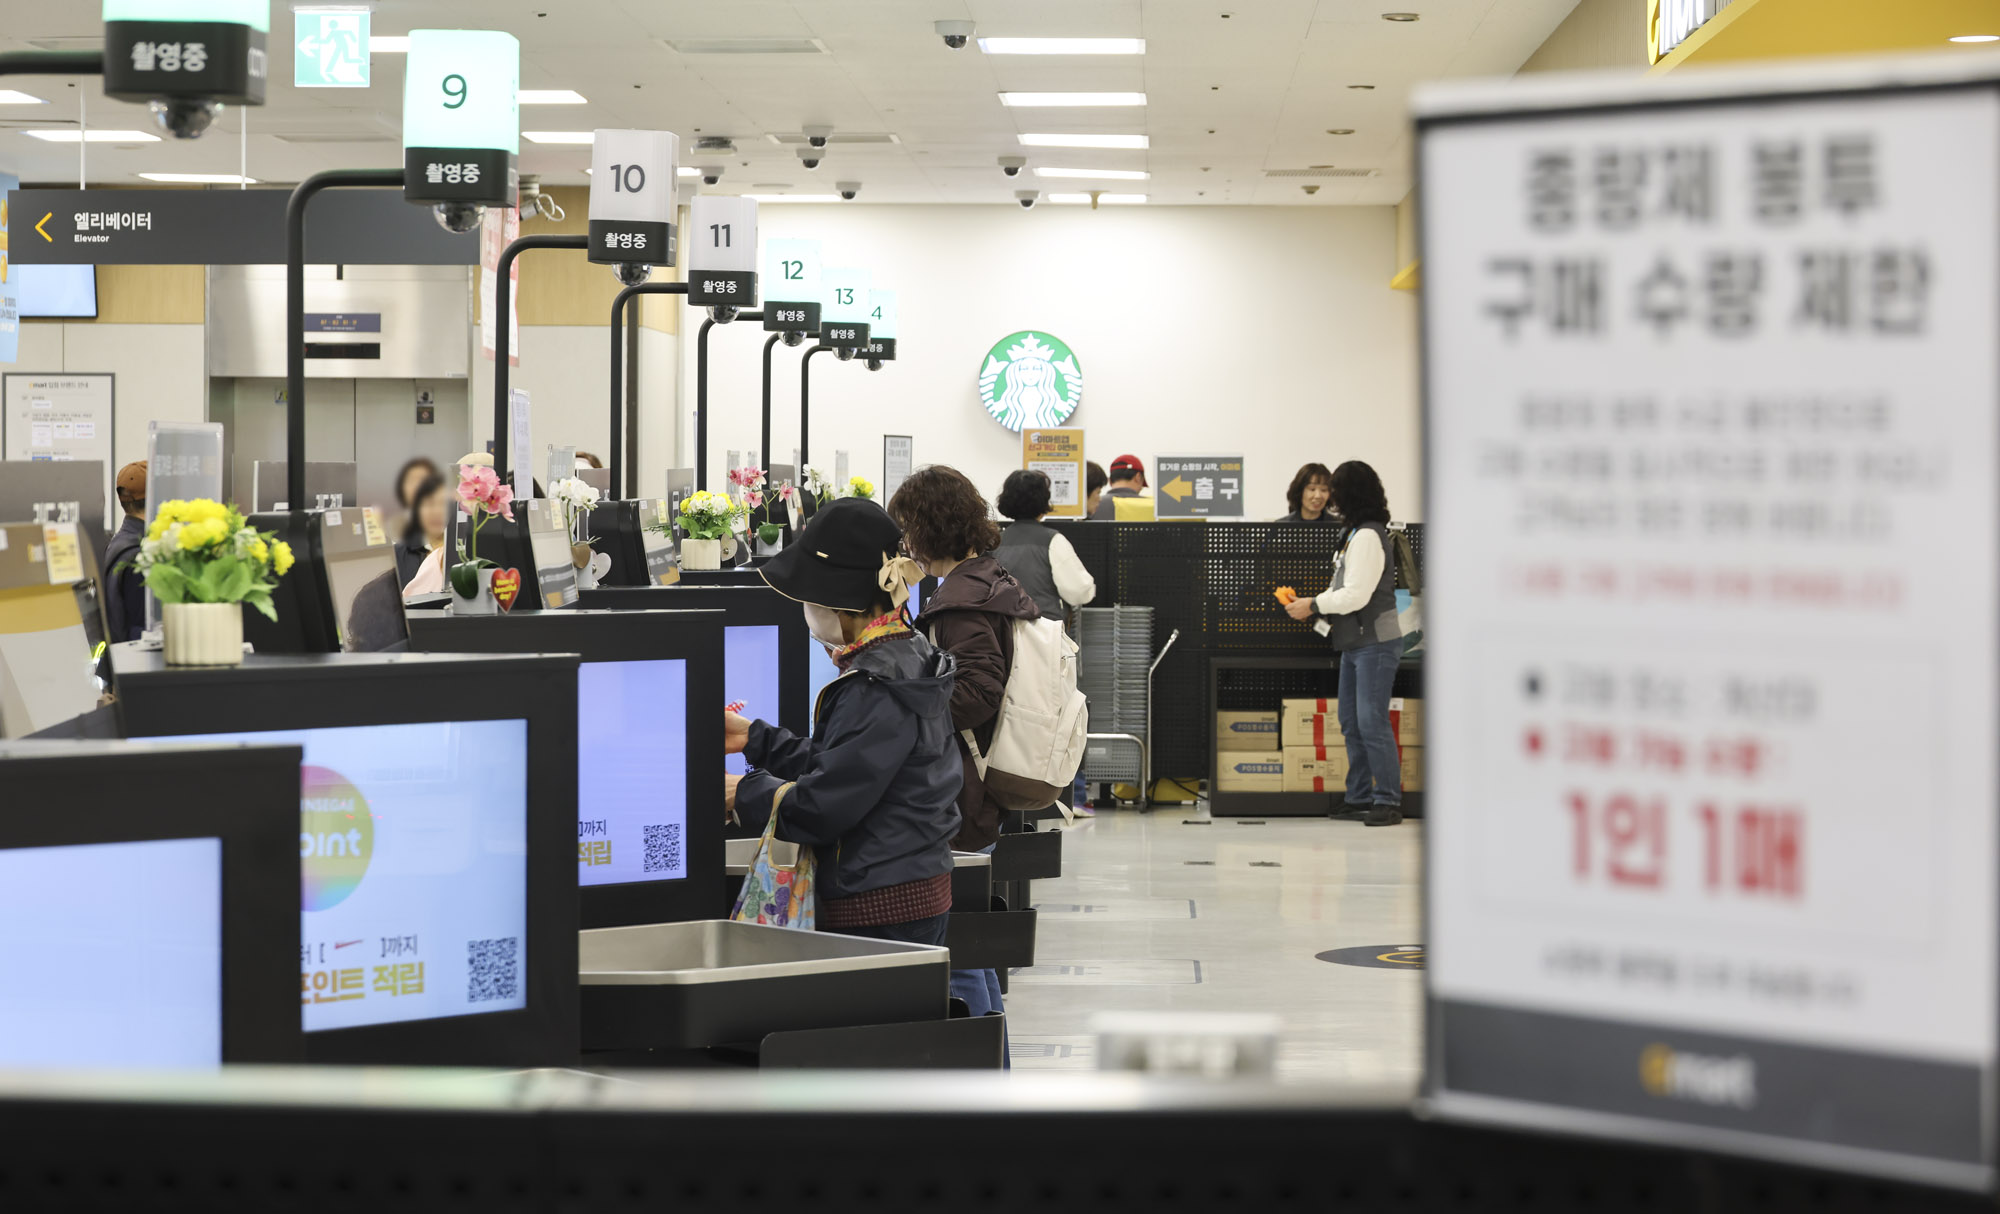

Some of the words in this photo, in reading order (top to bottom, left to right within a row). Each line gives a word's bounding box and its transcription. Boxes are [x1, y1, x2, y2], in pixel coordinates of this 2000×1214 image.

[131, 41, 208, 72] 촬영중
[442, 74, 468, 109] 9
[426, 163, 480, 184] 촬영중
[610, 164, 645, 193] 10
[74, 212, 152, 231] 엘리베이터
[74, 234, 110, 242] Elevator
[605, 232, 647, 249] 촬영중
[710, 224, 731, 248] 11
[781, 260, 804, 280] 12
[703, 280, 738, 293] 촬영중
[835, 288, 854, 305] 13
[776, 310, 806, 321] 촬영중
[871, 305, 882, 320] 4
[830, 329, 855, 339] 촬영중
[1160, 462, 1180, 471] 즐거운
[1182, 462, 1202, 471] 쇼핑의
[300, 827, 361, 857] oint
[1563, 789, 1667, 887] 1인
[1695, 800, 1805, 903] 1매
[372, 961, 424, 996] 적립
